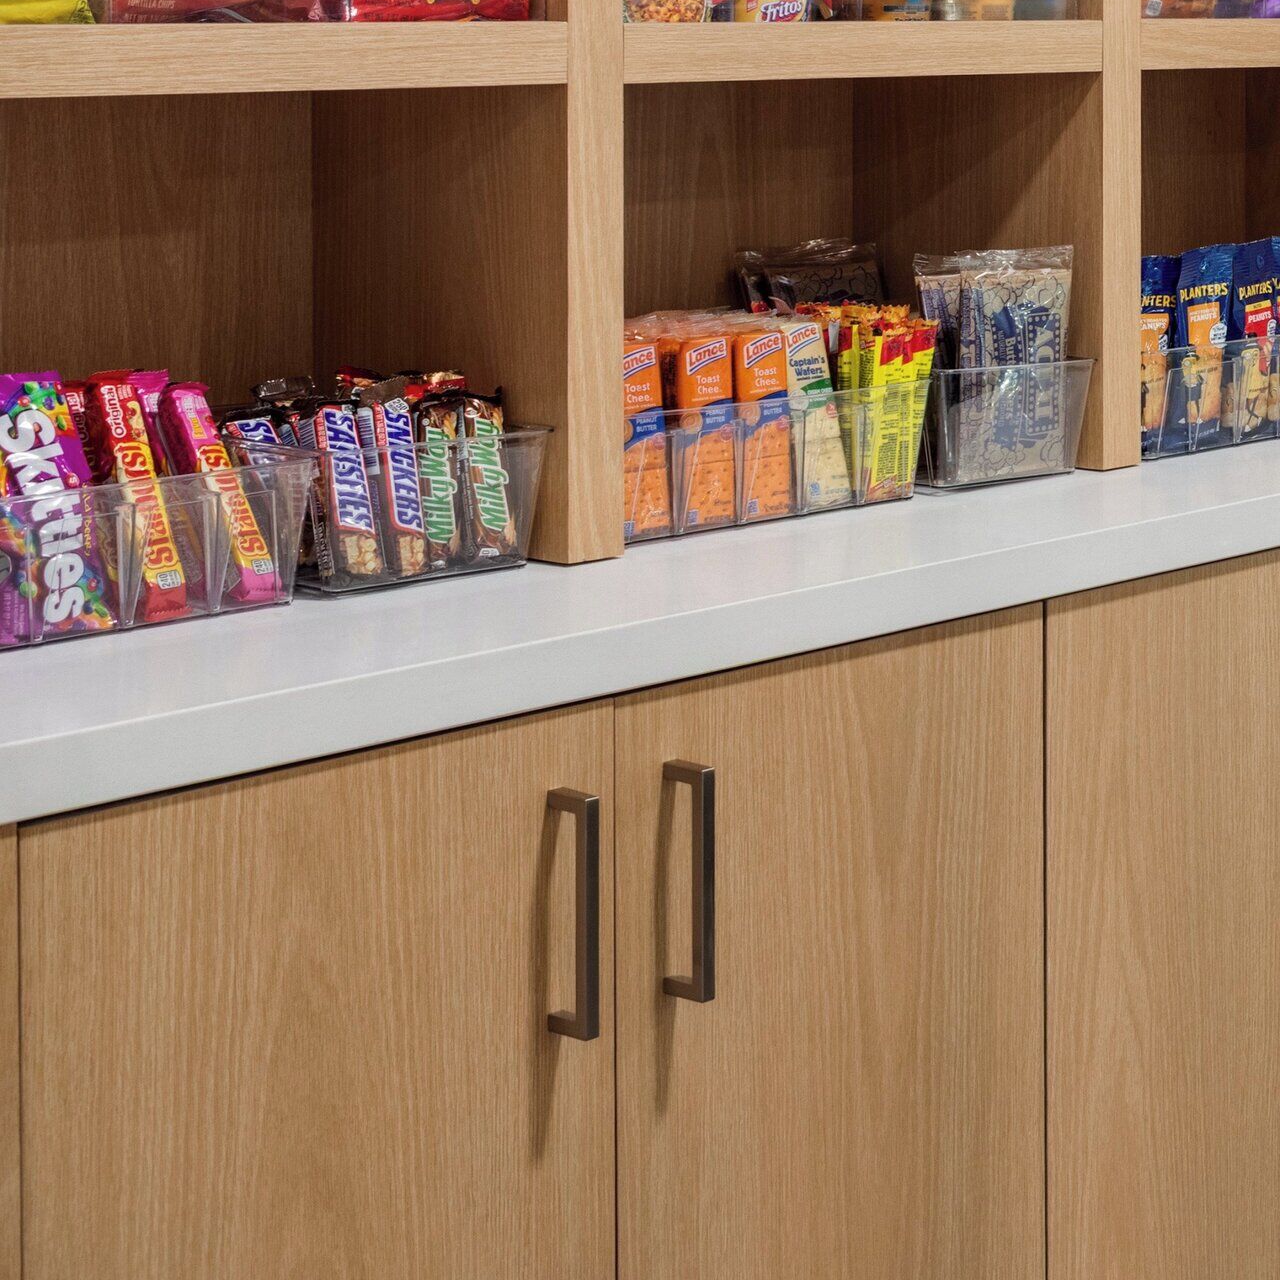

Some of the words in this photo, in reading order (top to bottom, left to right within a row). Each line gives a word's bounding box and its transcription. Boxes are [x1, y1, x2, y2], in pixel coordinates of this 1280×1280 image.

[761, 0, 802, 22] Fritos
[1180, 284, 1228, 303] PLANTERS
[1239, 281, 1272, 300] PLANTERS
[786, 326, 817, 348] Lance
[689, 343, 724, 367] Lance
[746, 337, 778, 361] Lance
[754, 367, 776, 377] Toast
[790, 356, 825, 367] Captain's
[696, 375, 720, 383] Toast
[101, 385, 127, 438] Original
[396, 400, 407, 411] 250
[419, 427, 449, 478] Way
[469, 418, 502, 467] Way
[474, 467, 509, 531] Milky
[0, 409, 85, 623] Skittles
[422, 479, 458, 543] Milky
